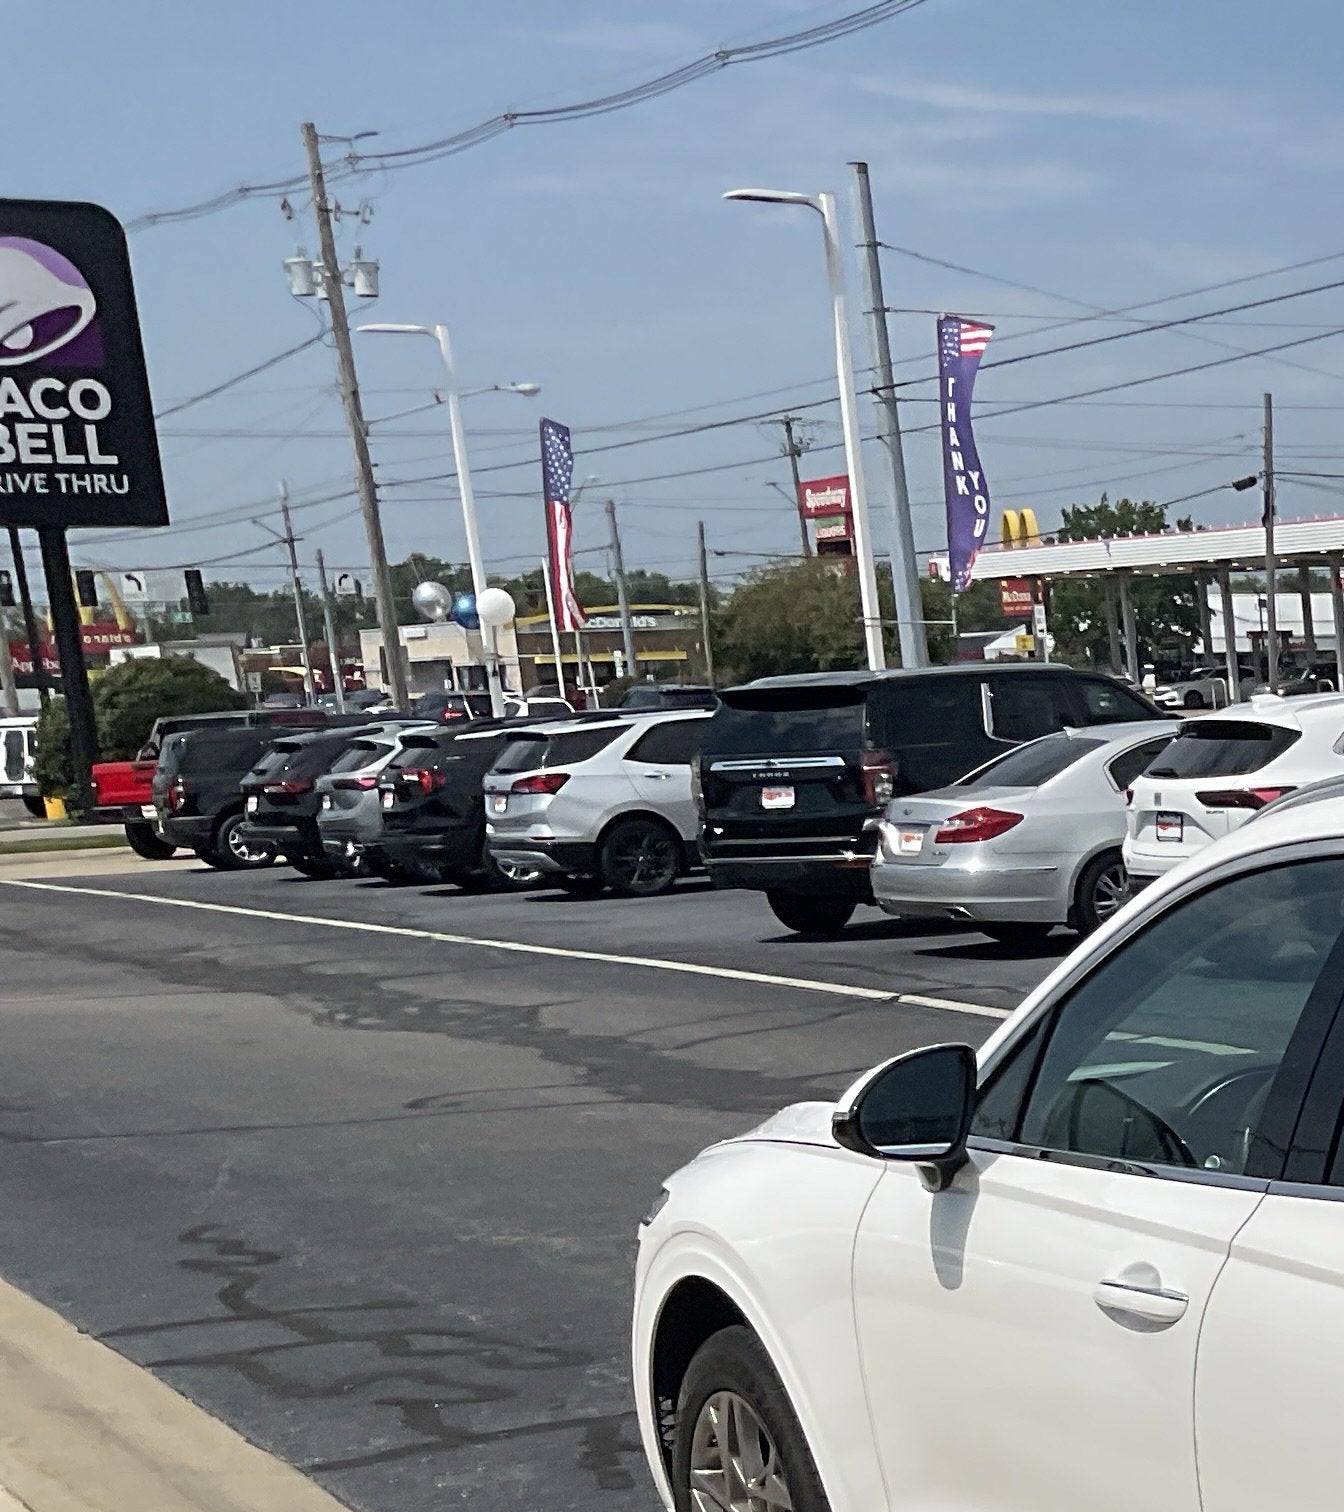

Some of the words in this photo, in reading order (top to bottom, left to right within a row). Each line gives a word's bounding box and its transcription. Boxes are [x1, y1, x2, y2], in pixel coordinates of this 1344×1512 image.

[54, 473, 129, 494] THRU
[947, 377, 970, 496] THANK
[968, 471, 987, 537] YOU
